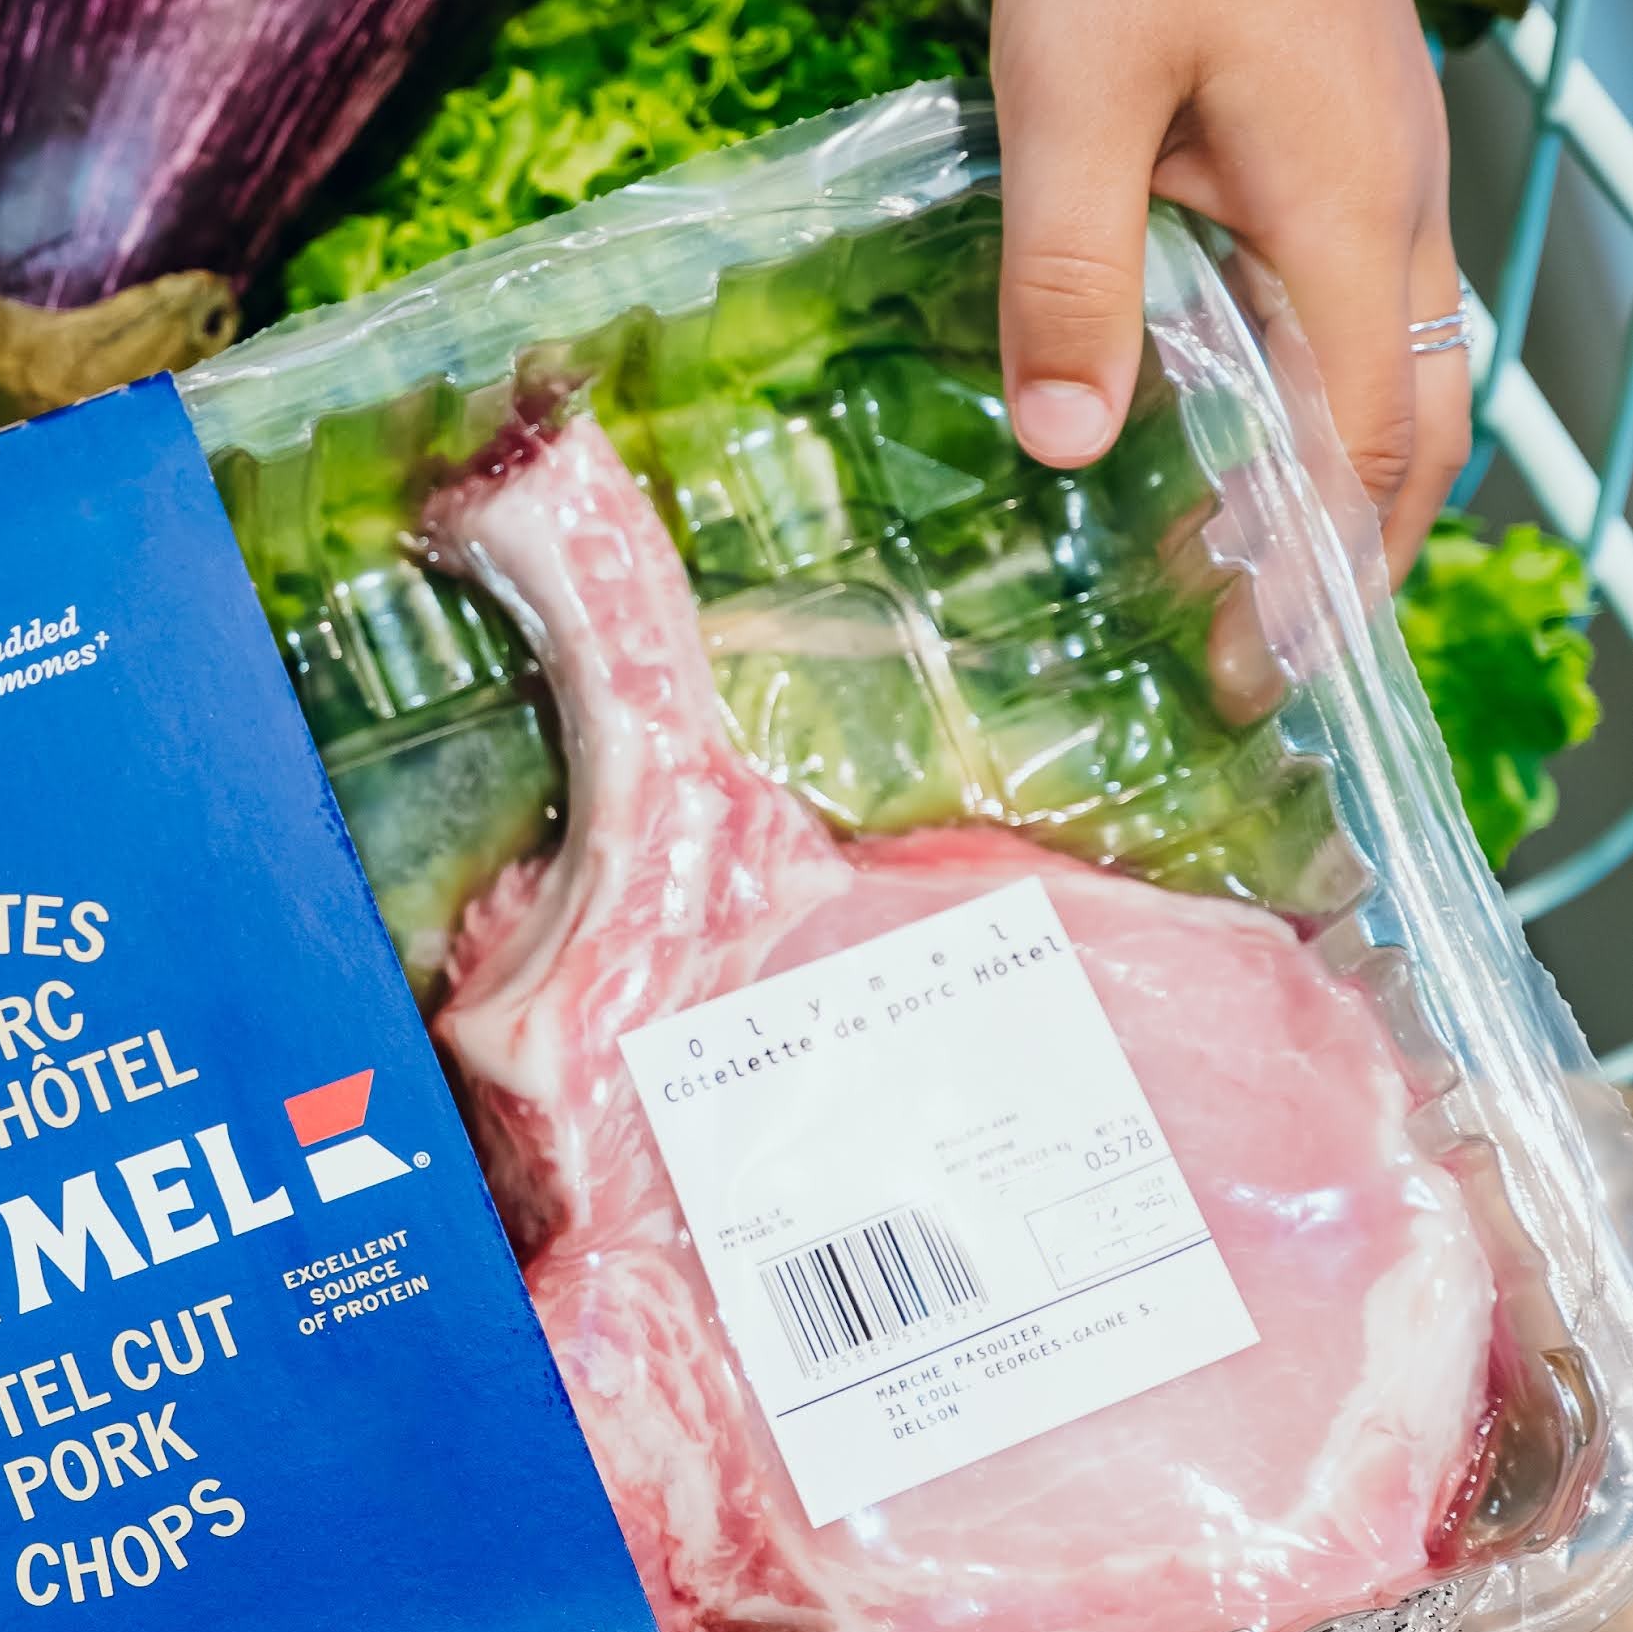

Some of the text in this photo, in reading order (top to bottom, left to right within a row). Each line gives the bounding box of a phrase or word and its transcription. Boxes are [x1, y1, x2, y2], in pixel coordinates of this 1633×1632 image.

[664, 936, 1062, 1103] Côtelette de porc Hôtel
[1085, 1129, 1152, 1171] 0.578
[283, 1230, 407, 1289] EXCELLENT
[310, 1259, 402, 1305] SOURCE
[298, 1275, 429, 1335] OF PROTEIN
[111, 1295, 242, 1392] CUT
[876, 1324, 1042, 1400] MARCHE PASQUIER
[893, 1403, 959, 1440] DELSON
[3, 1402, 199, 1522] PORK
[15, 1477, 246, 1608] CHOPS
